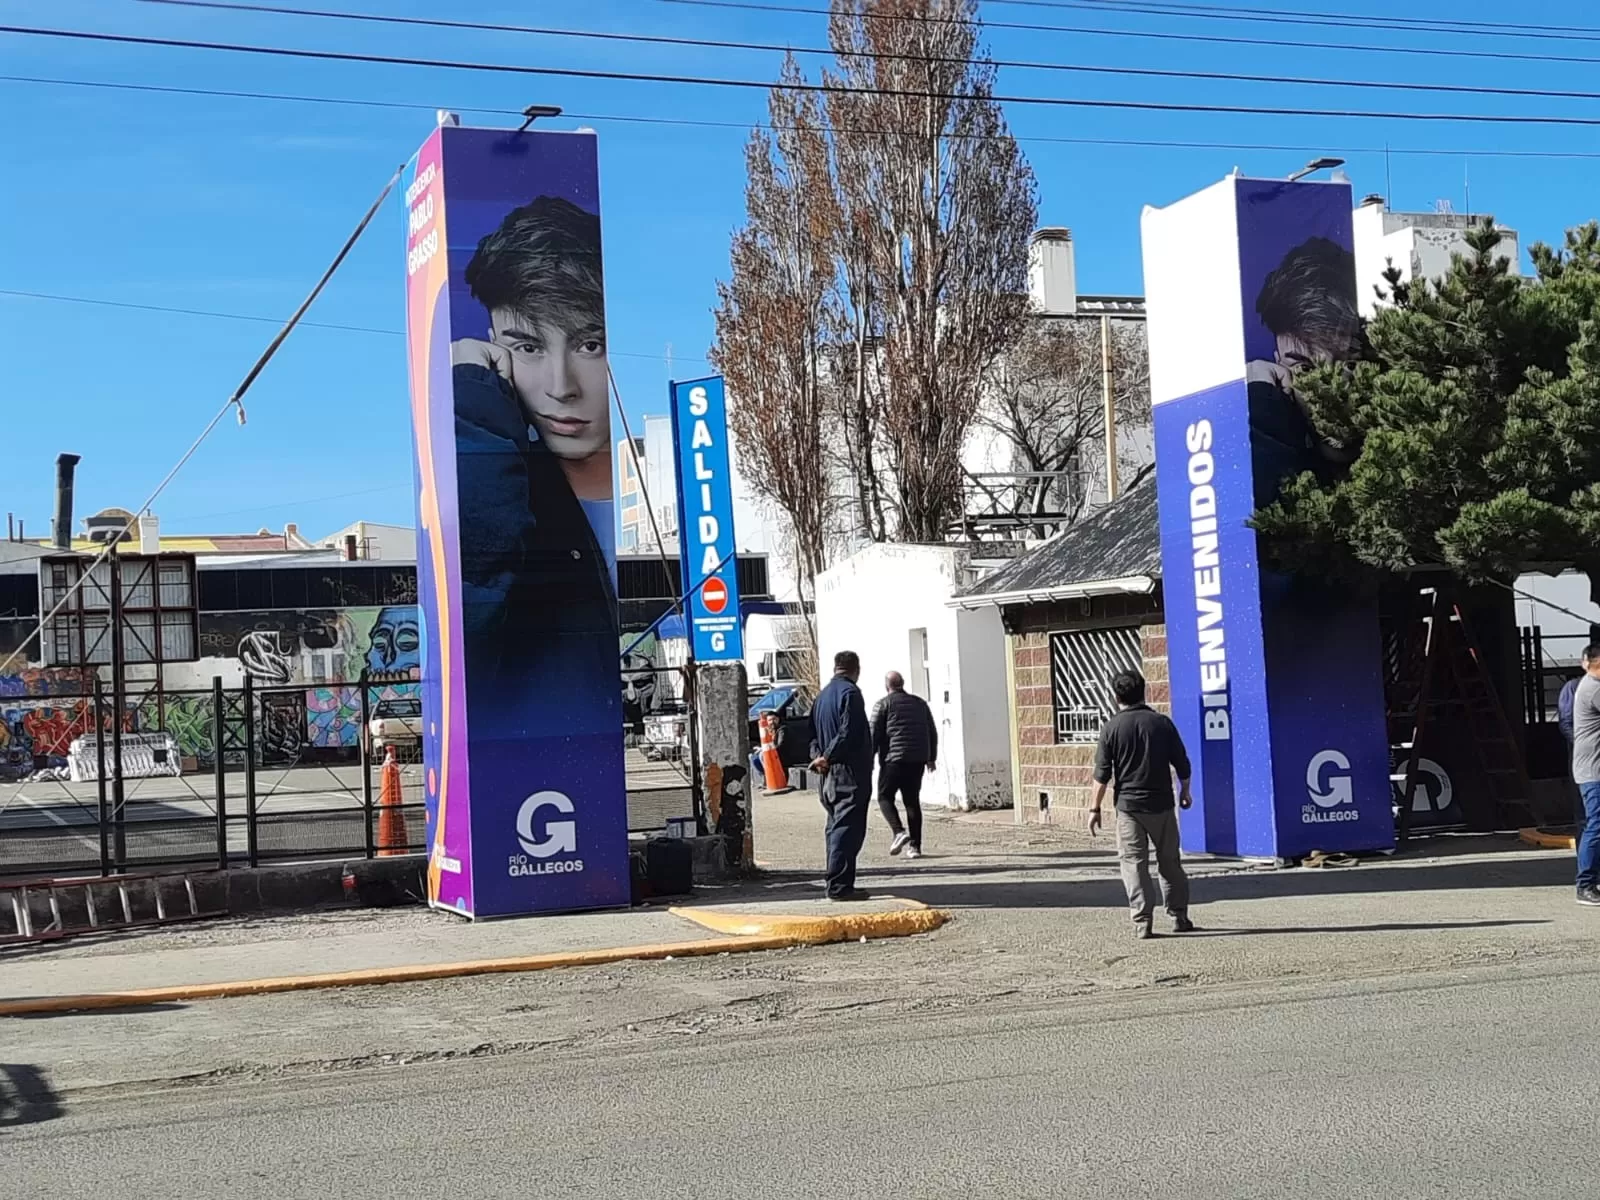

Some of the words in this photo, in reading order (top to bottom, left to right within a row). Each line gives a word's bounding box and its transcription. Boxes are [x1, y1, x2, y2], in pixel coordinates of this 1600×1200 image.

[408, 193, 433, 238] PABLO
[408, 228, 438, 276] GRASSO
[689, 386, 722, 574] SALIDA
[1186, 419, 1230, 740] BIENVENIDOS
[711, 632, 725, 652] G
[1302, 810, 1359, 823] GALLEGOS
[508, 860, 583, 876] GALLEGOS
